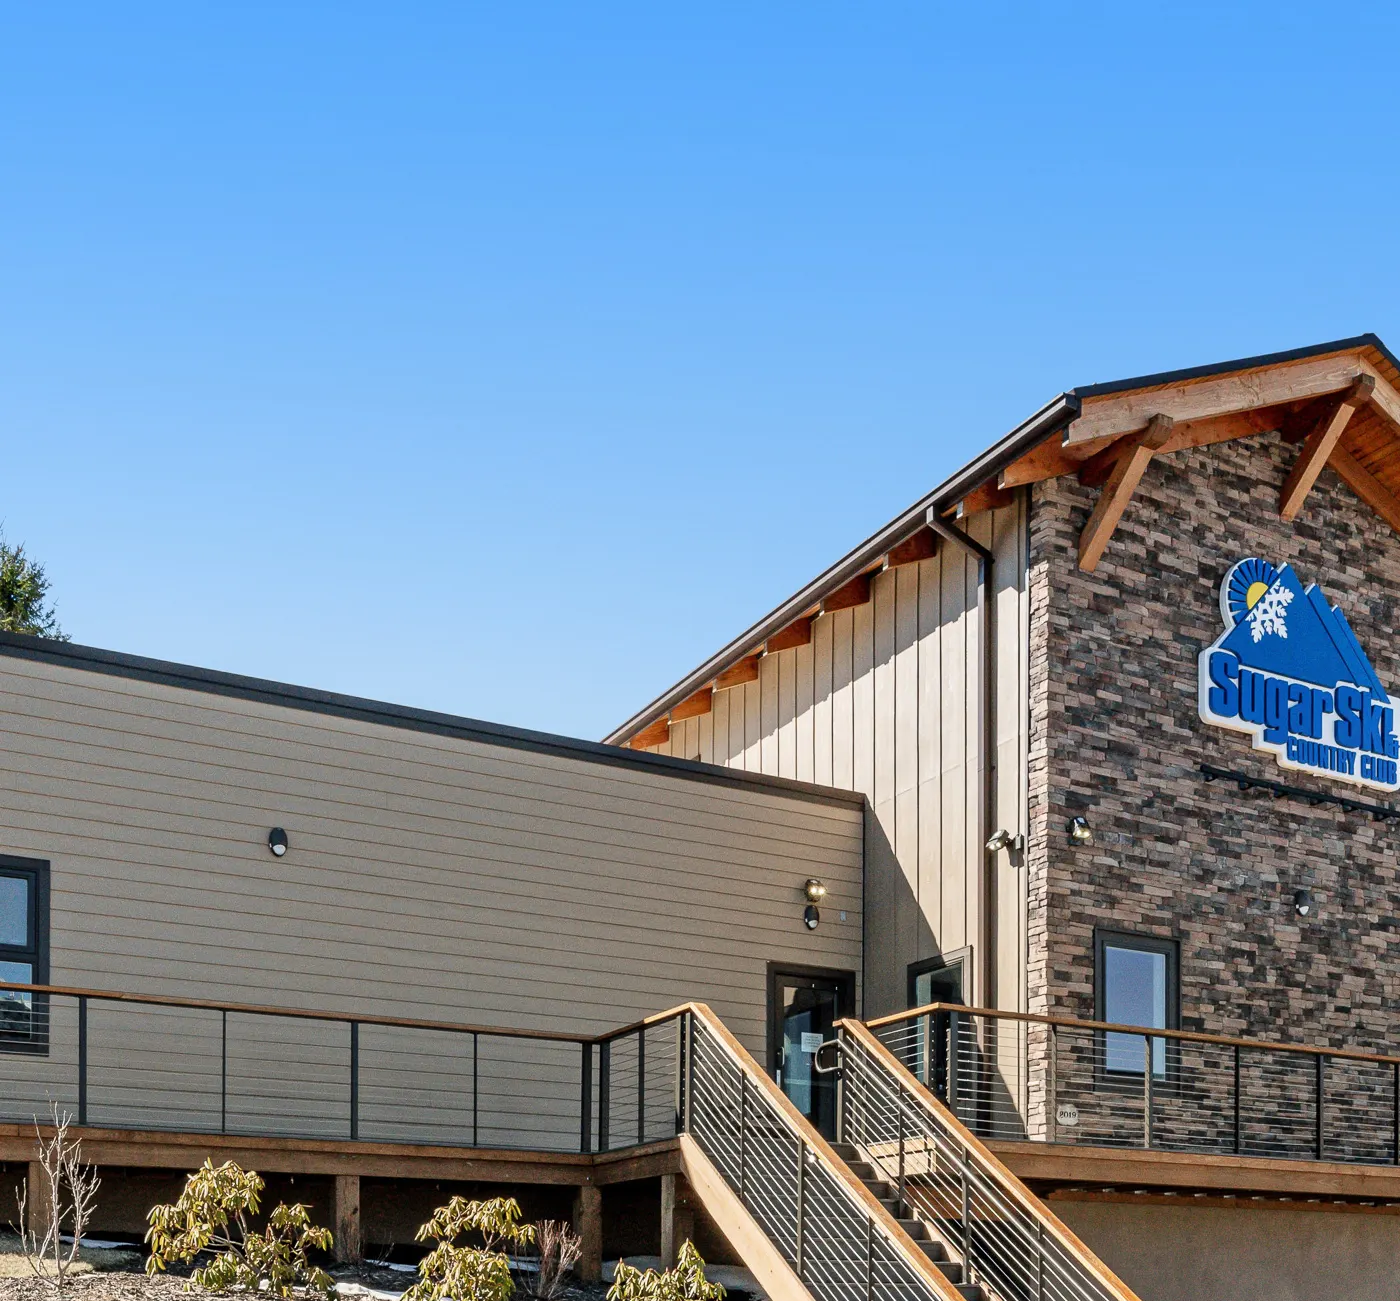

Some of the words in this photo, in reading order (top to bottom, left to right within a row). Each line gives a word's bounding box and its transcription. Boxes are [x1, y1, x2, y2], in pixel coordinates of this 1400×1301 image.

[1209, 651, 1333, 745] Sugar
[1287, 735, 1356, 776] COUNTRY
[1361, 754, 1397, 785] CLUB
[1059, 1110, 1077, 1119] 2019
